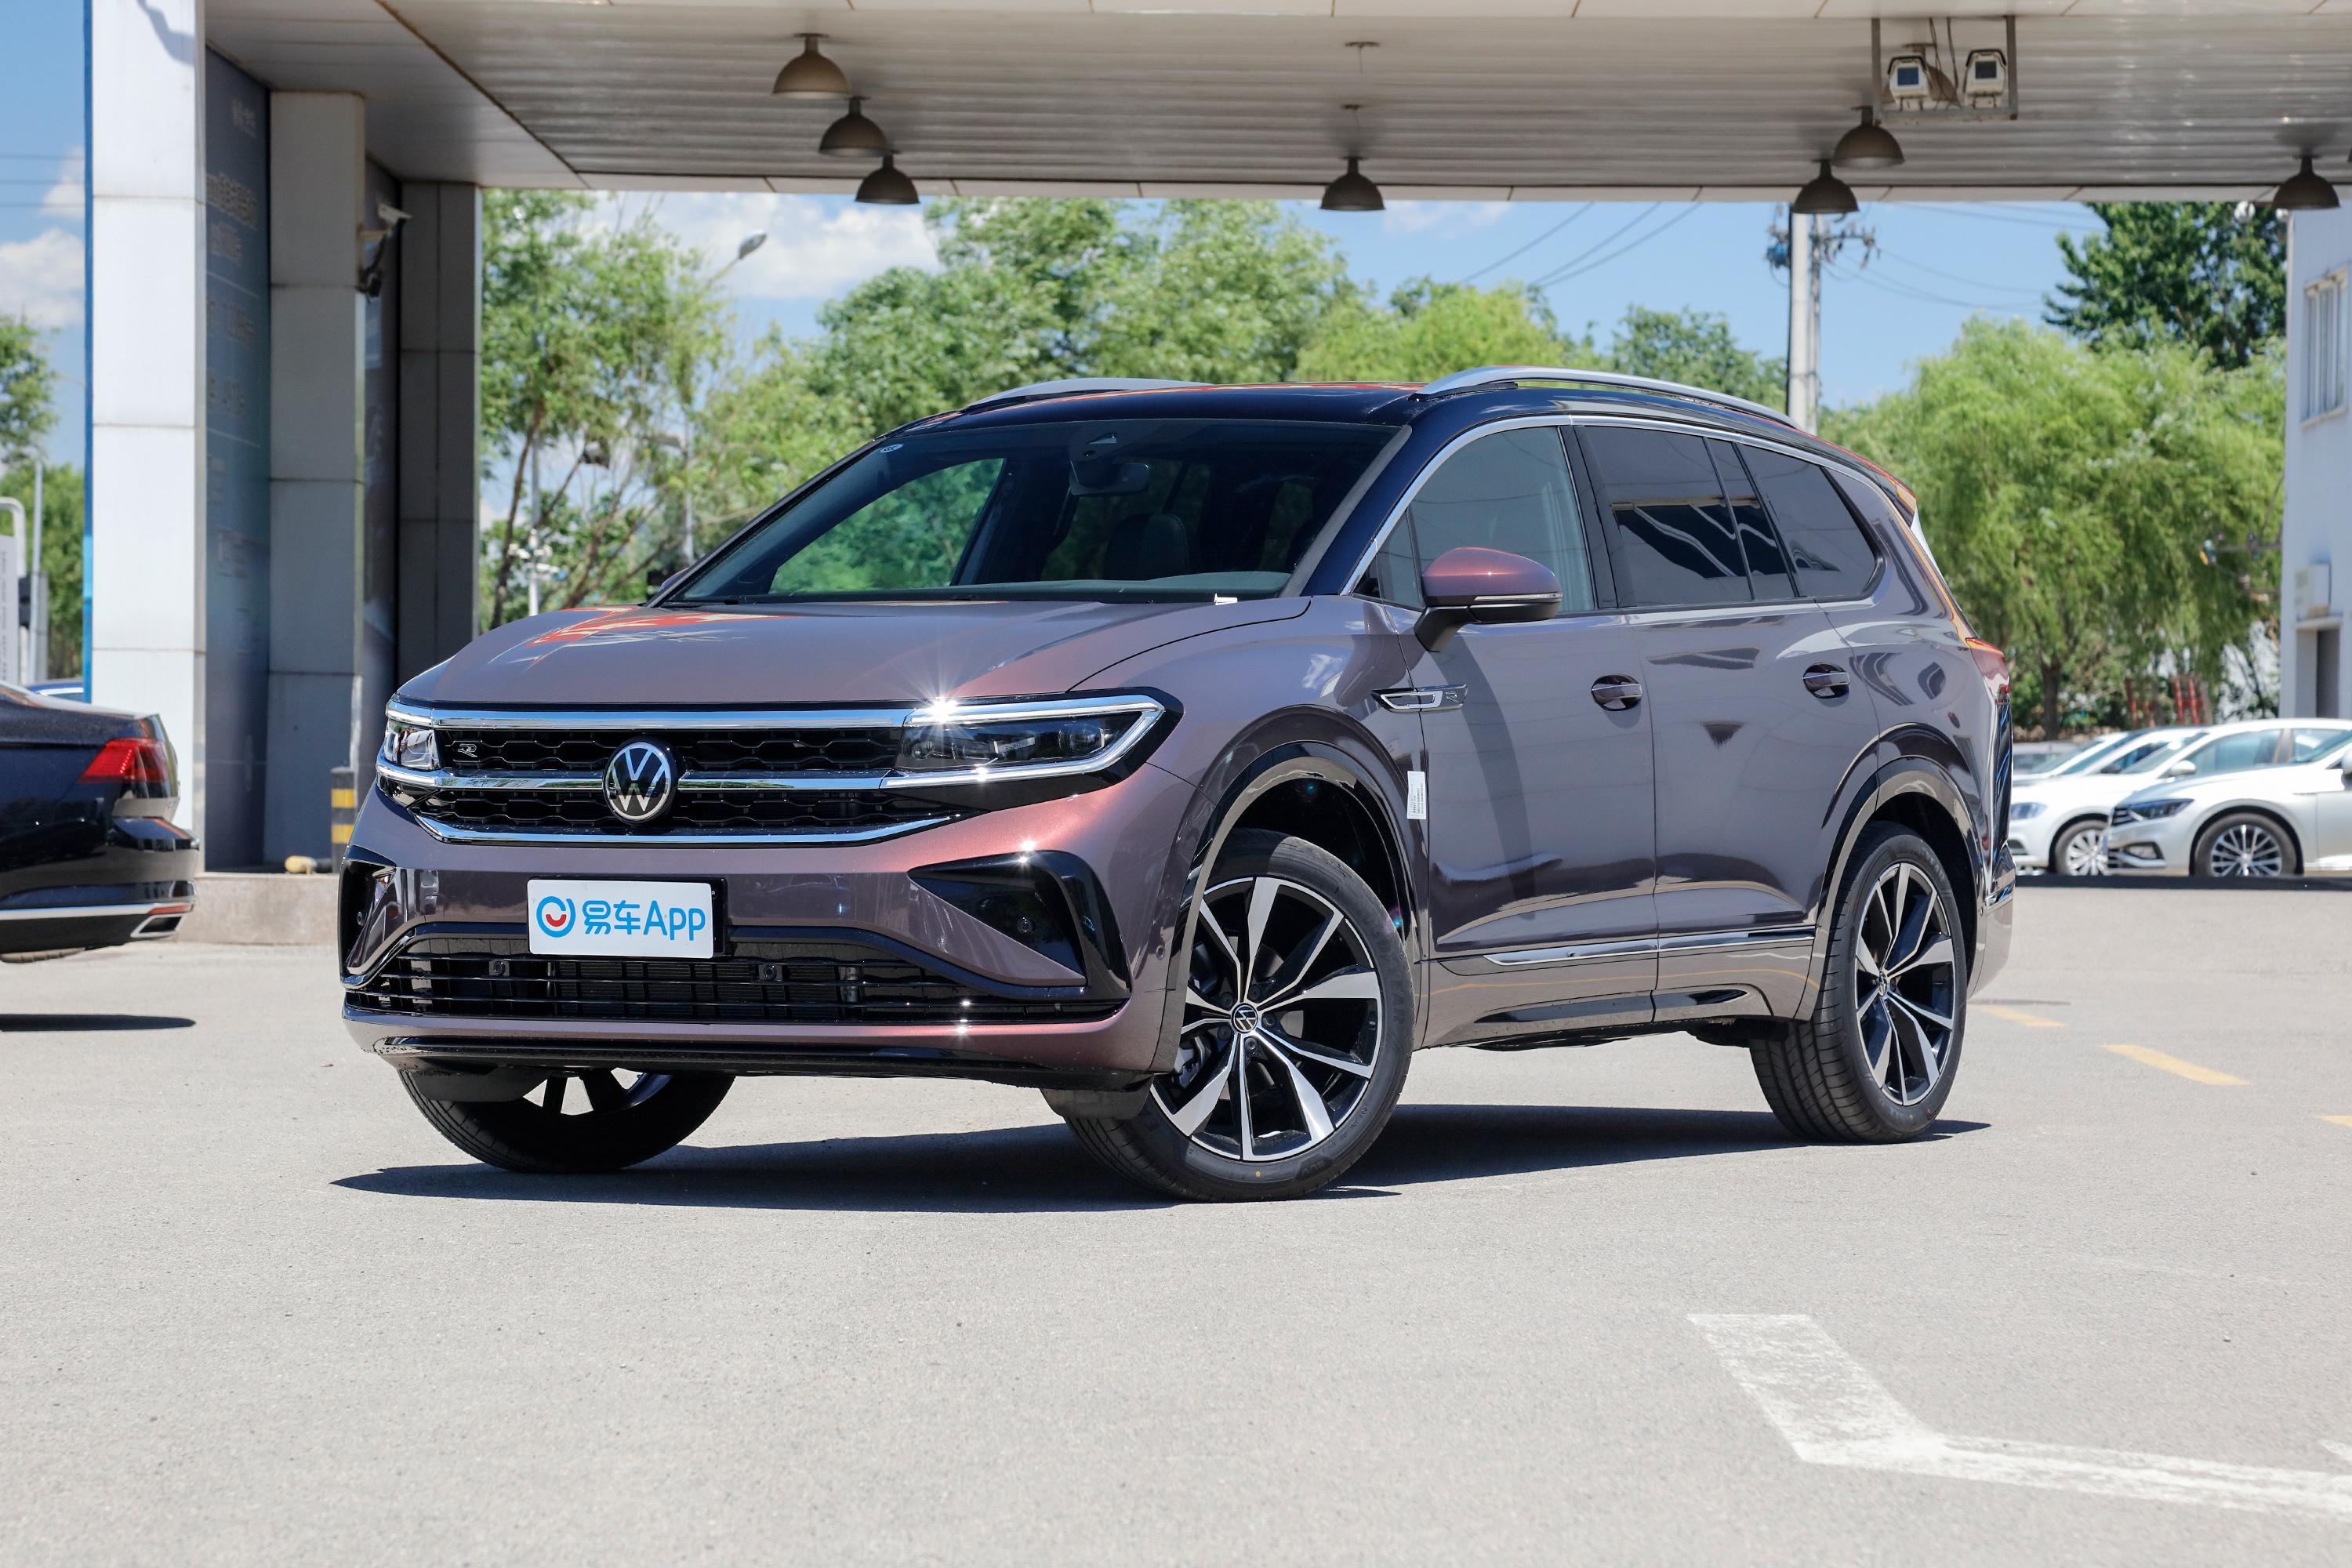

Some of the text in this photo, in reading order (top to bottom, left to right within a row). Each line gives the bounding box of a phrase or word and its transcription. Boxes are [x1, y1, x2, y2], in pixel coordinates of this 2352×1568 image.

[458, 743, 478, 758] R
[607, 744, 670, 815] VW
[582, 899, 706, 941] 易车App
